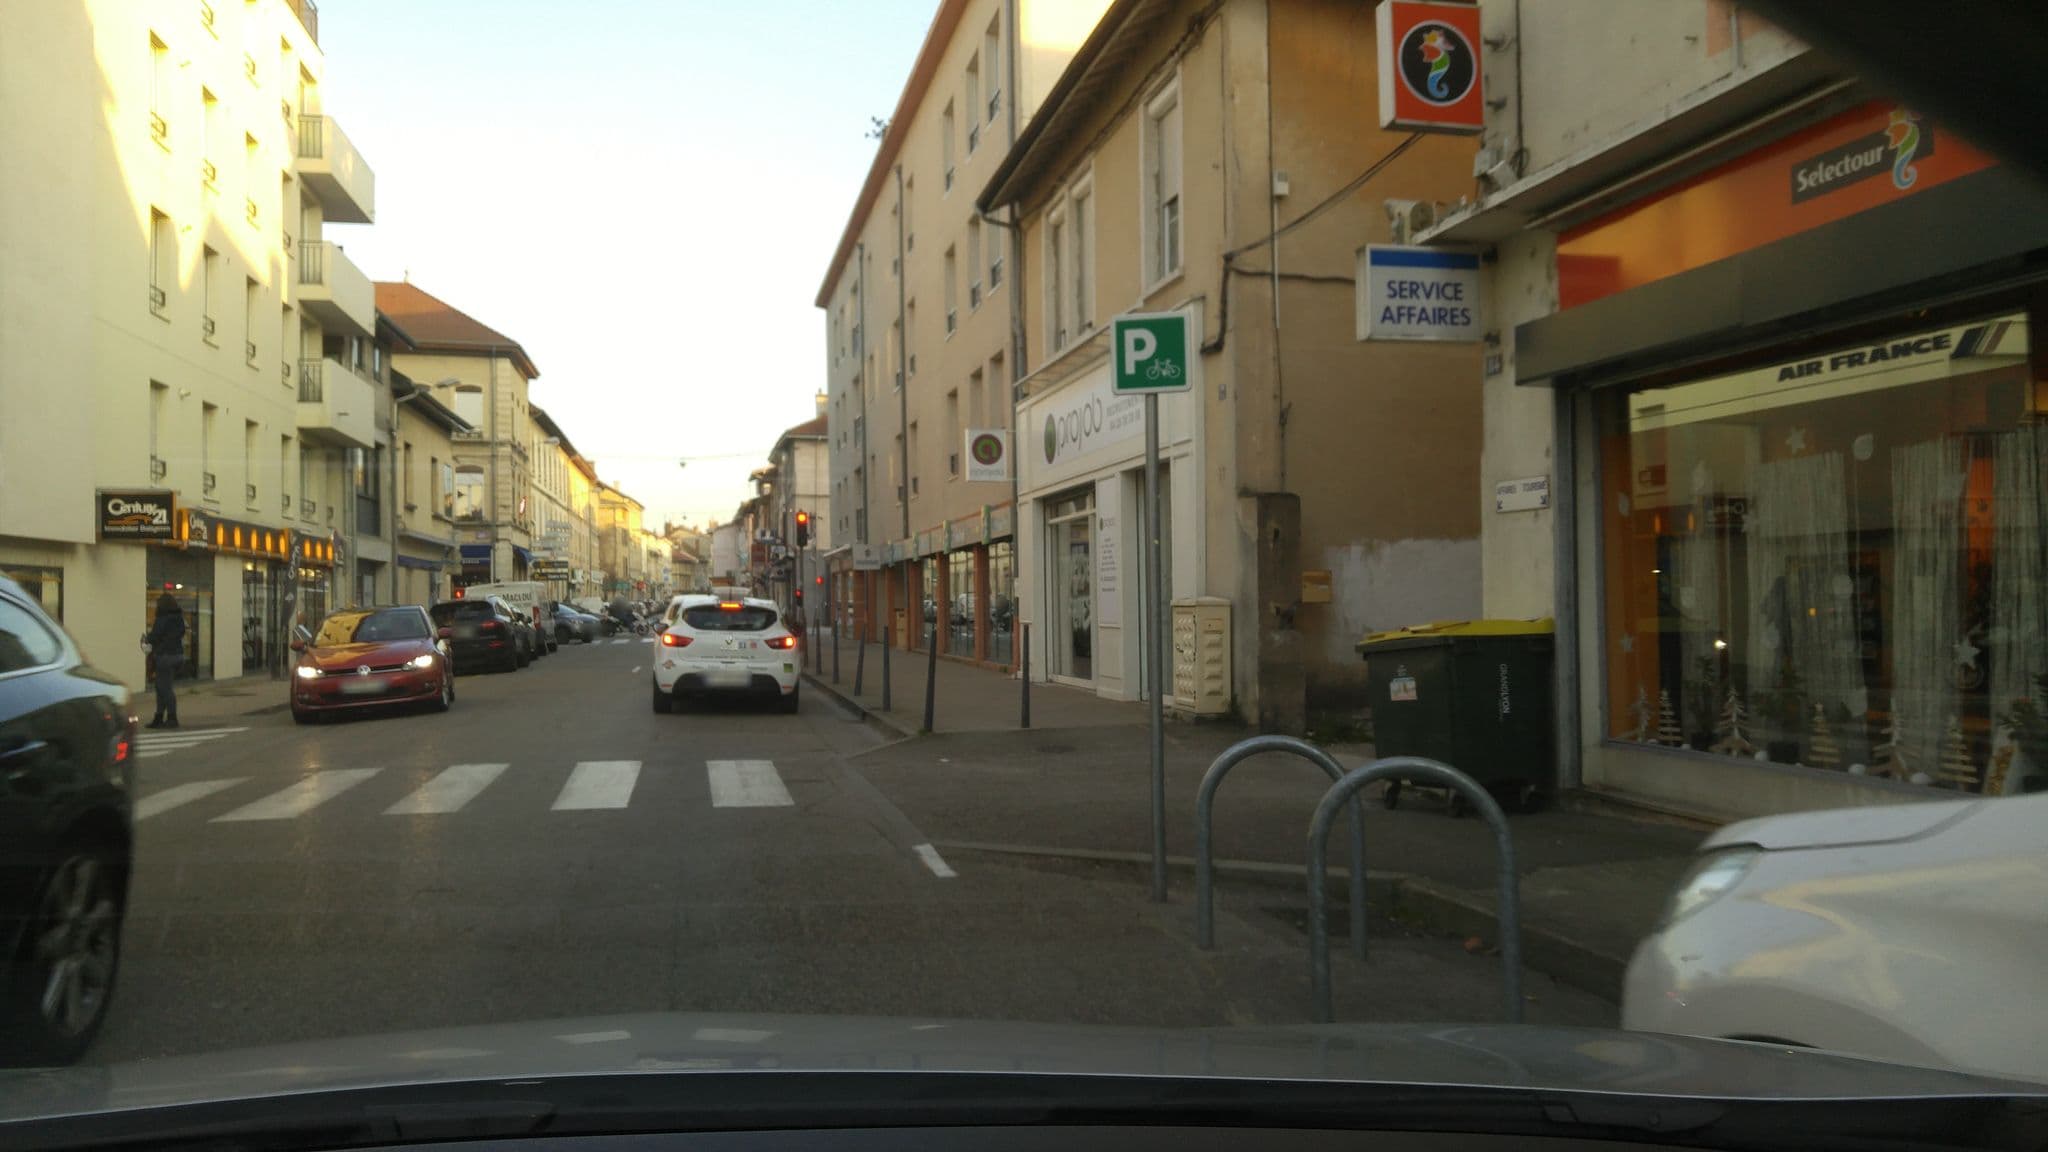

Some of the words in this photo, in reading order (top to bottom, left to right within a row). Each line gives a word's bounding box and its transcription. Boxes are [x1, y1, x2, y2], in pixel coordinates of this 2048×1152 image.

[1797, 146, 1885, 193] Selectour
[1386, 280, 1464, 302] SERVICE
[1381, 305, 1471, 327] AFFAIRES
[1124, 327, 1157, 376] P
[1778, 360, 1824, 382] AIR
[1830, 334, 1953, 371] FRANCE
[1057, 392, 1103, 457] projob
[107, 498, 157, 517] Century
[152, 508, 168, 525] 21
